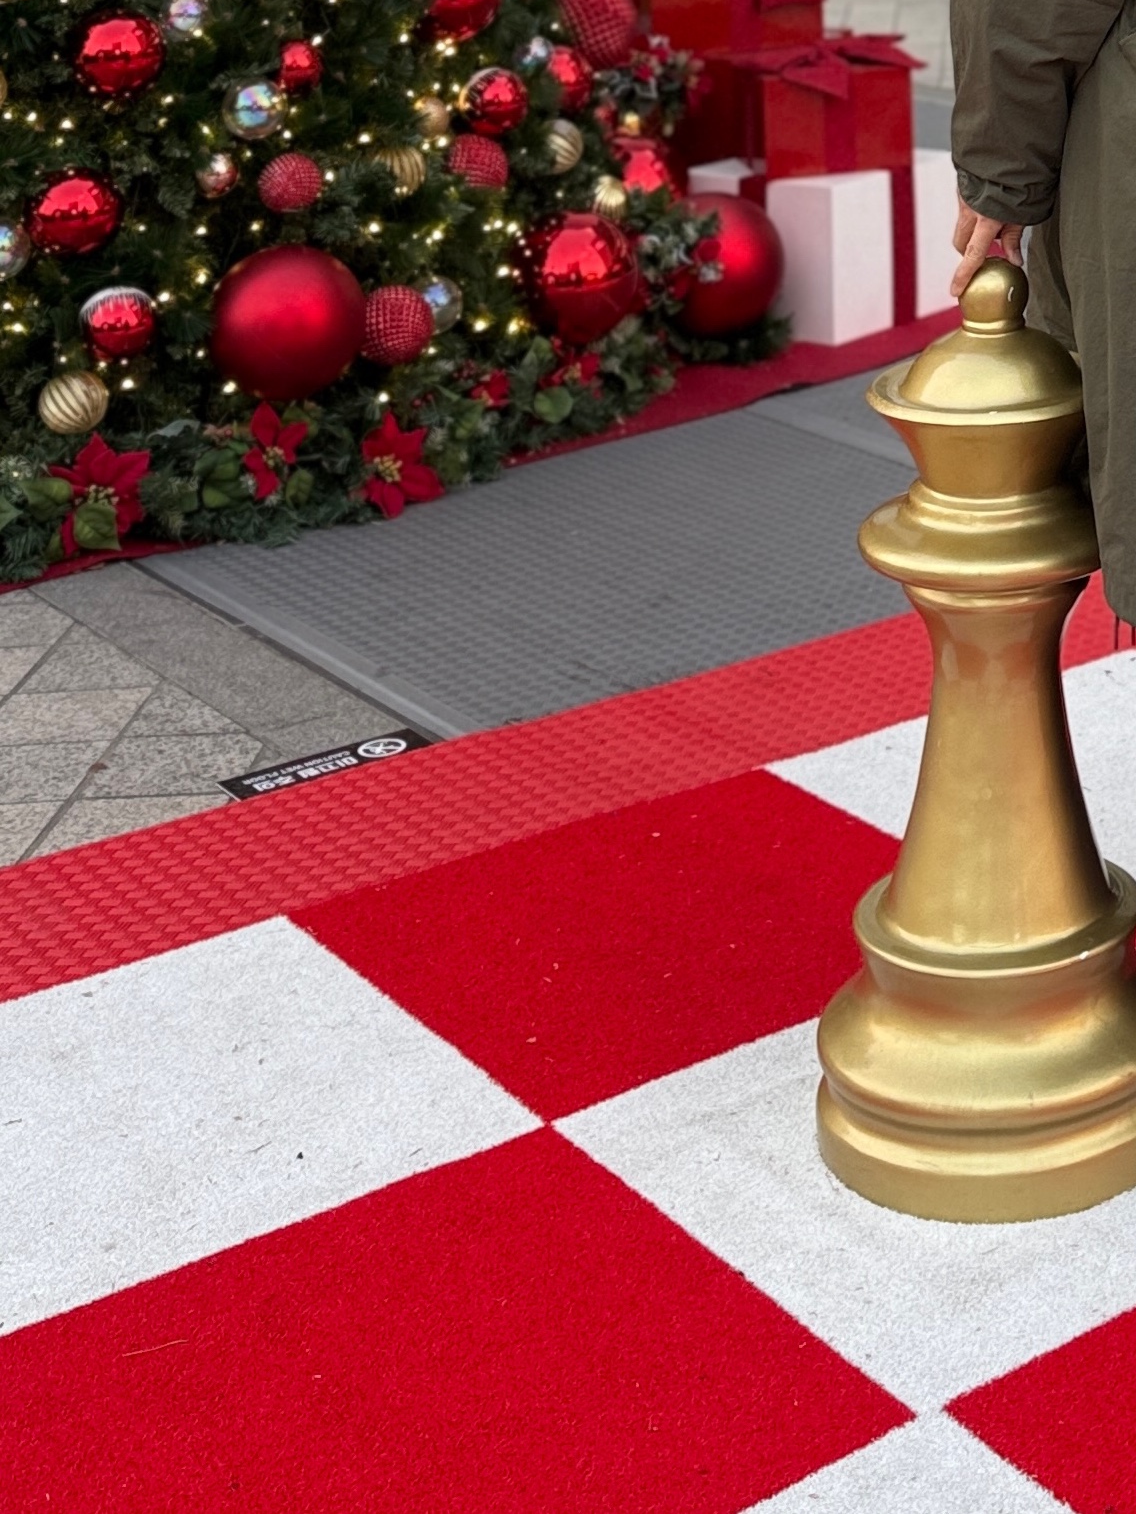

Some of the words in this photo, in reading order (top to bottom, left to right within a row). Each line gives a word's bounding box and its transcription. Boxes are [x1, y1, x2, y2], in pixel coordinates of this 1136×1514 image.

[304, 750, 351, 767] CAUTION
[280, 764, 304, 775] WET
[241, 771, 279, 785] FLOOR
[252, 775, 296, 792] 주의
